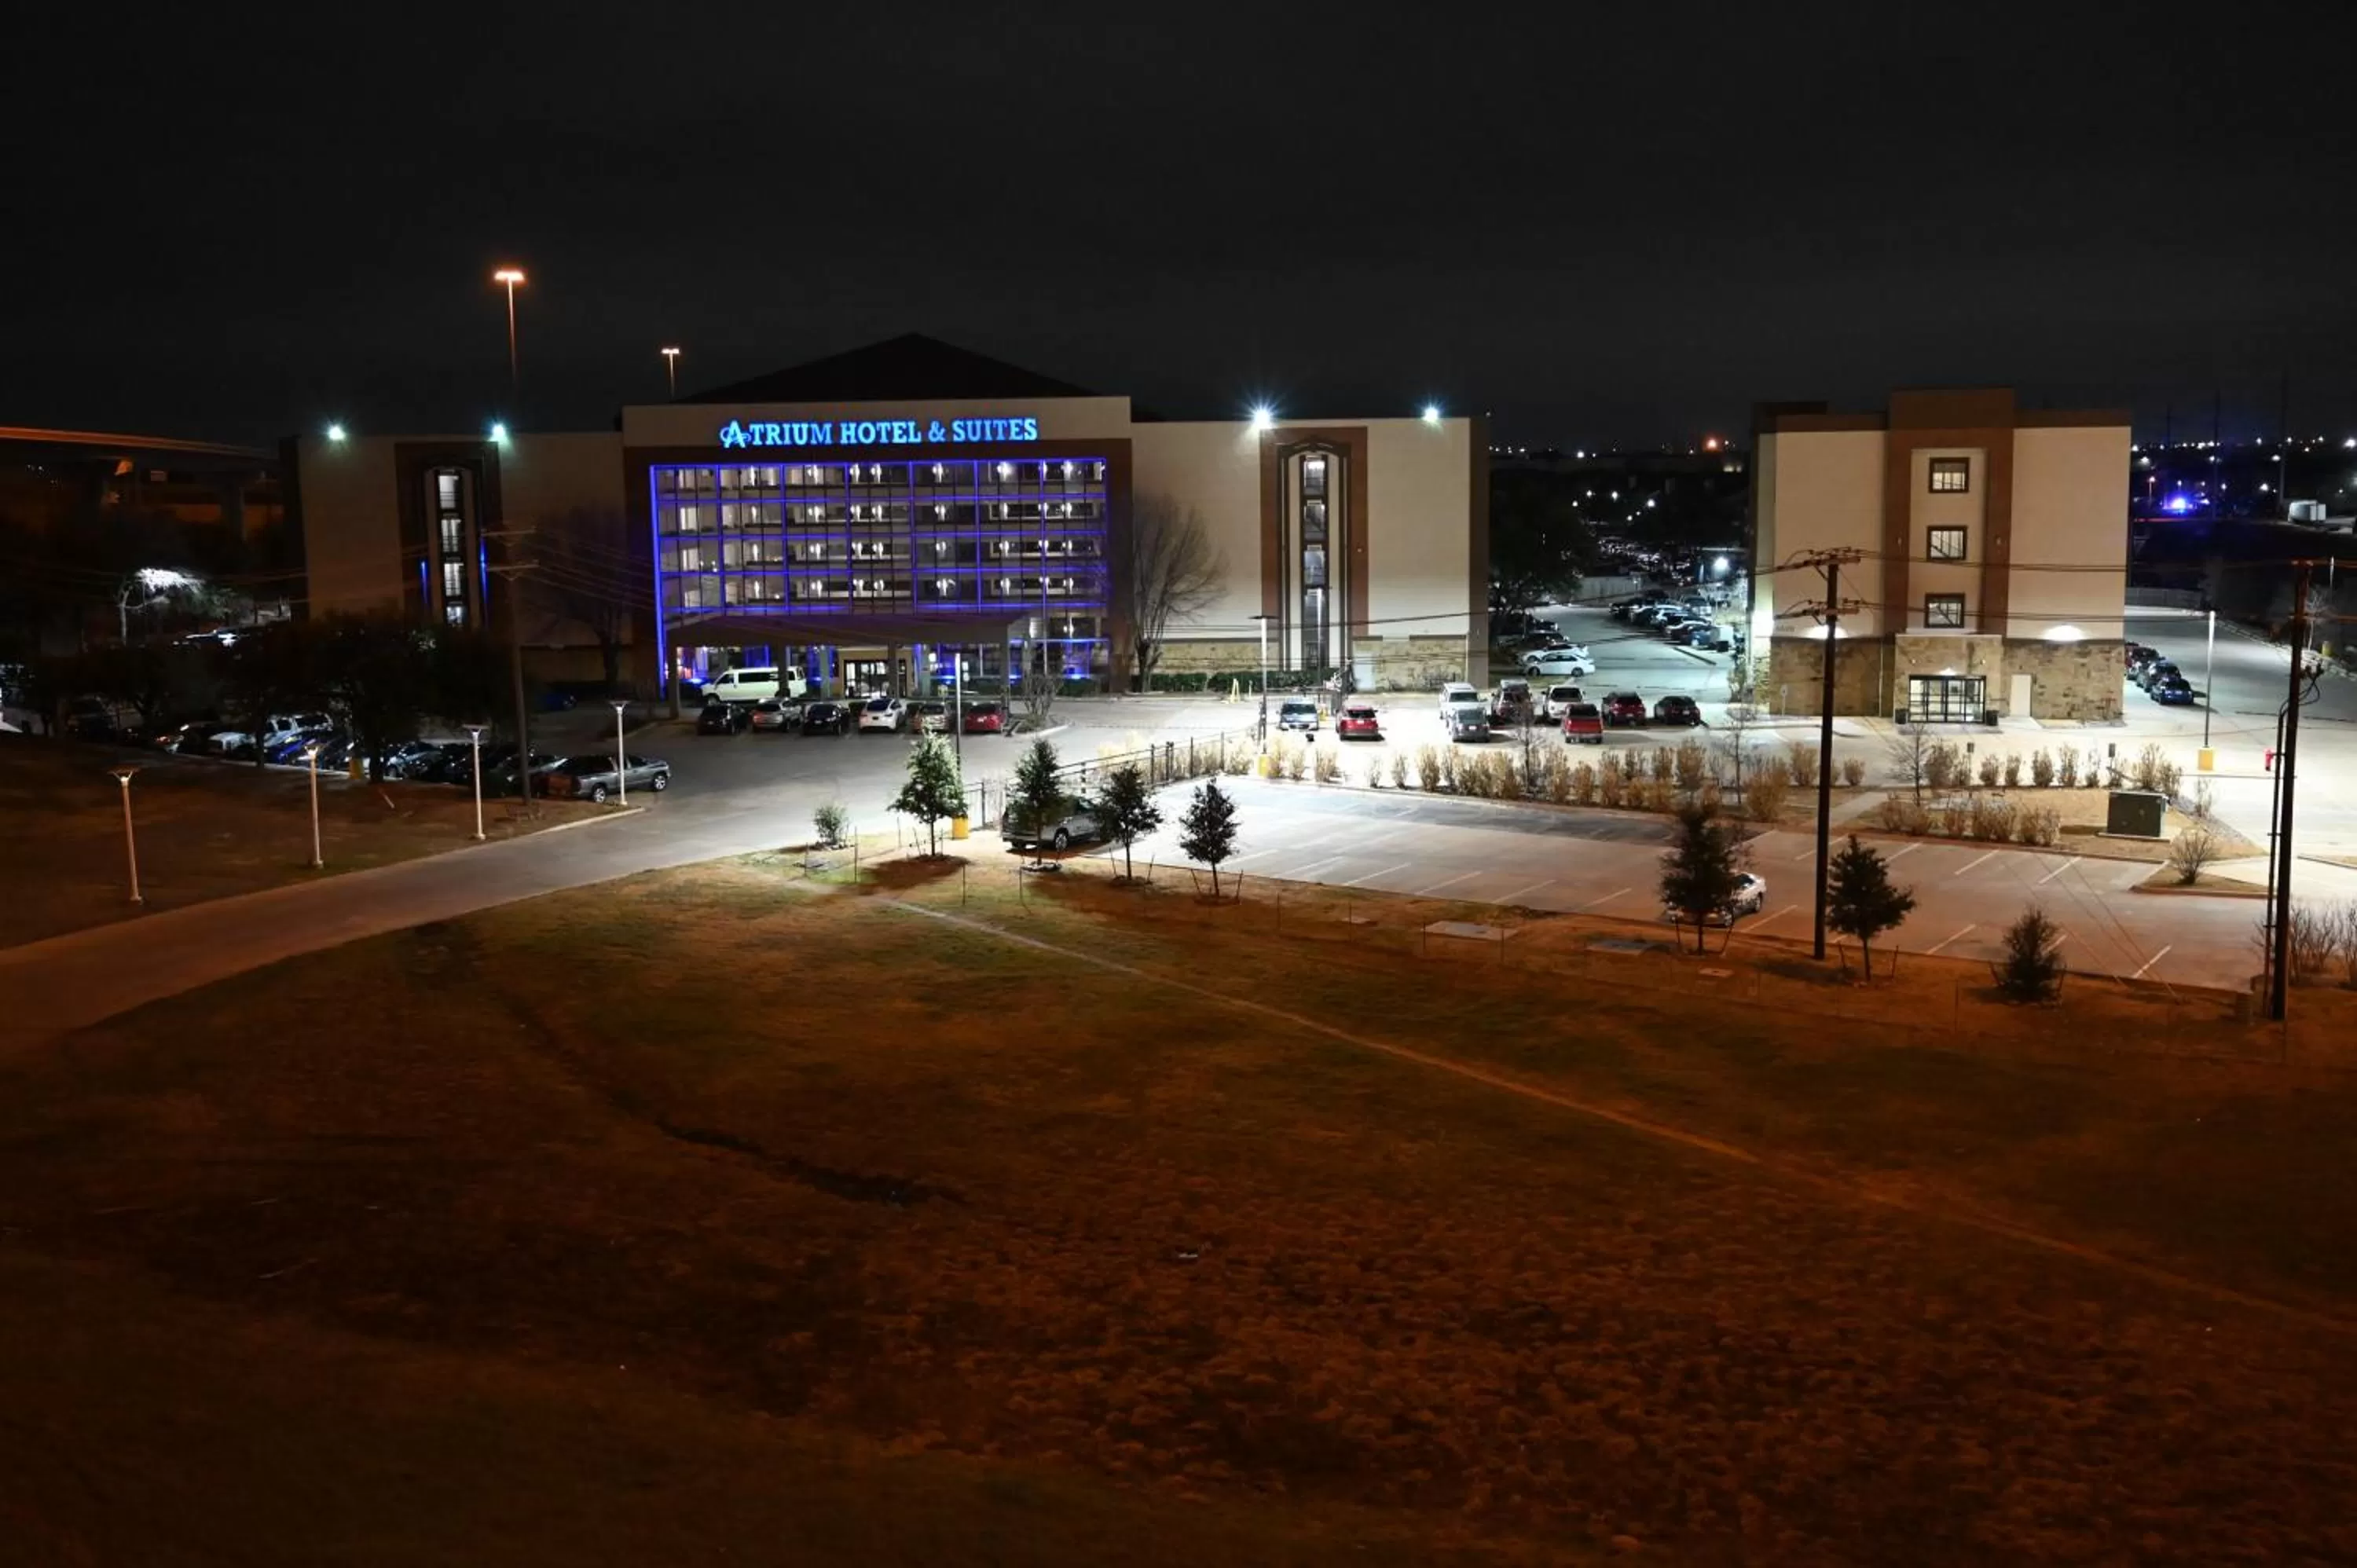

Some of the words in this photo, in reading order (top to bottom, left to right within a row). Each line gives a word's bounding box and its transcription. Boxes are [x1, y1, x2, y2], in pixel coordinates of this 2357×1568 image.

[720, 419, 832, 448] ATRIUM
[839, 420, 922, 445] HOTEL
[928, 419, 947, 442] &
[952, 417, 1038, 441] SUITES
